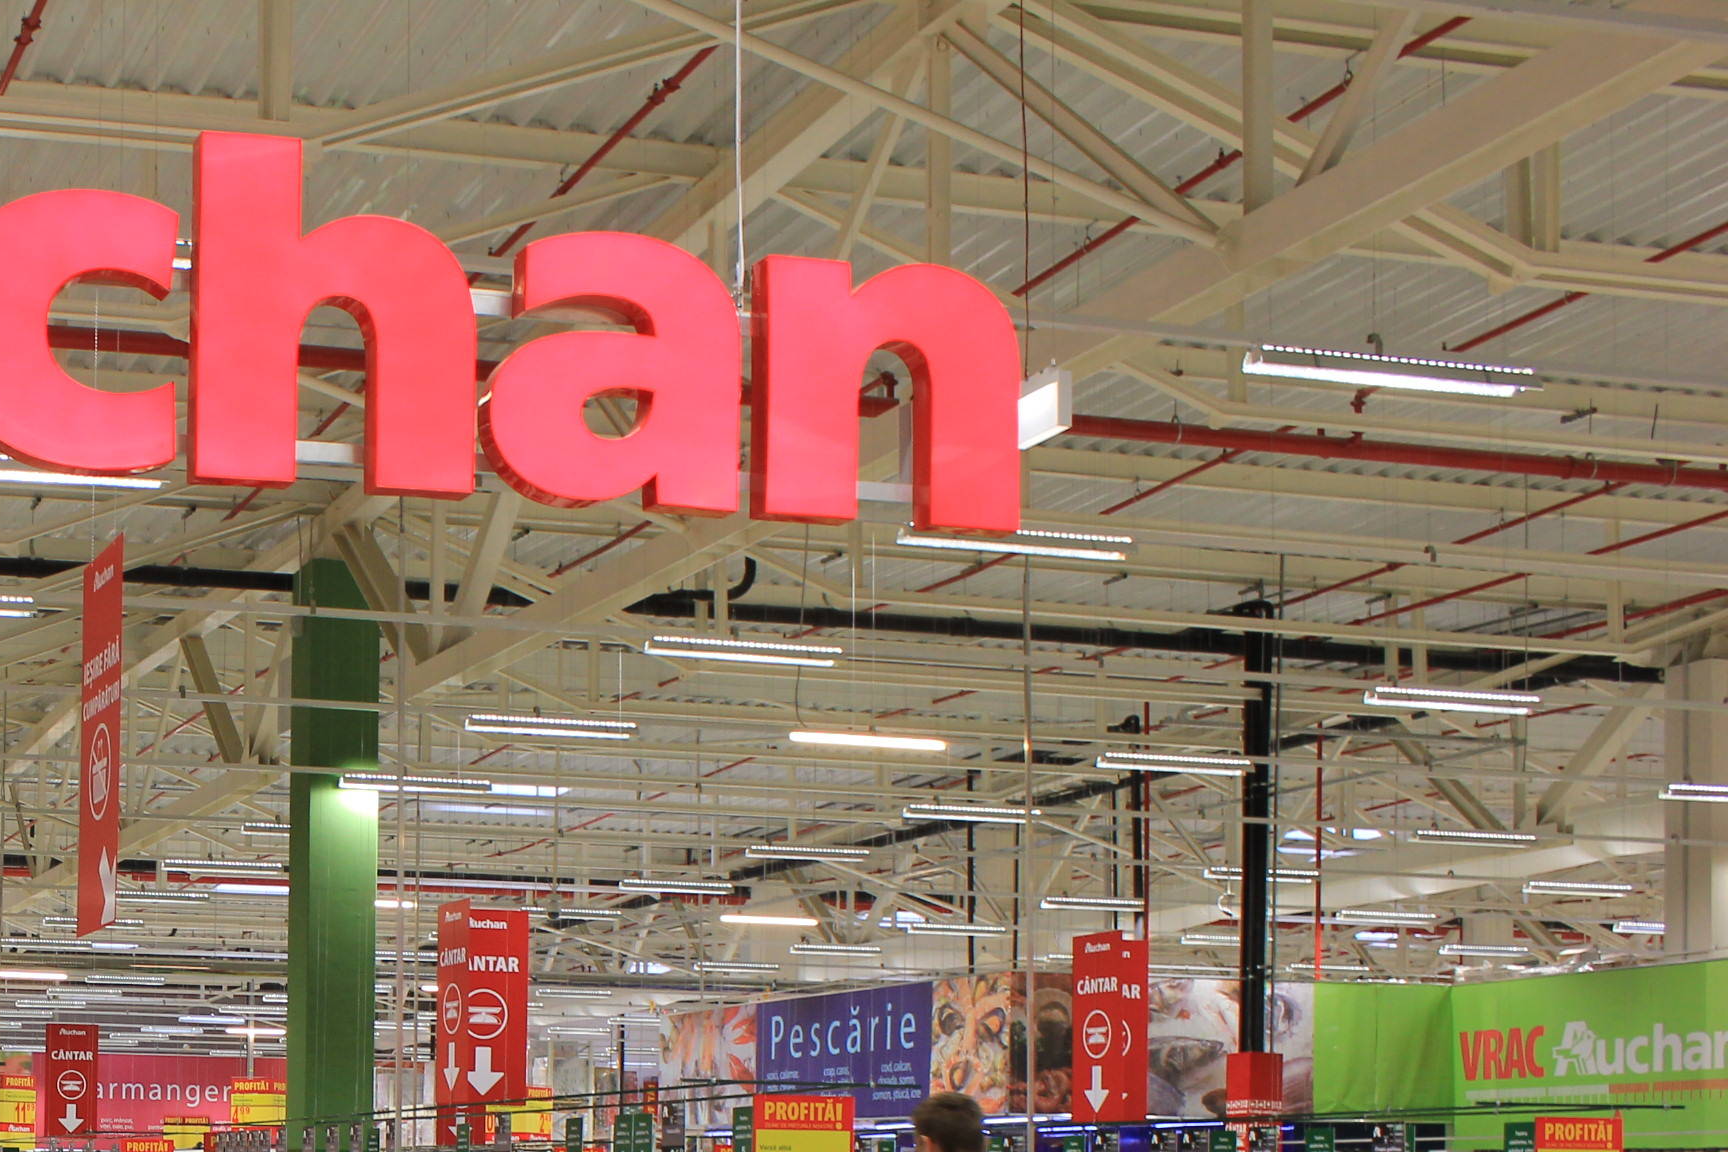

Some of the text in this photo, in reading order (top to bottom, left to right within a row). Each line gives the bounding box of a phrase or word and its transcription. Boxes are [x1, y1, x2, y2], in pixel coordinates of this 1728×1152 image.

[440, 947, 466, 967] CÂNTAR
[469, 955, 519, 972] NTAR
[1077, 975, 1118, 995] CÂNTAR
[59, 1027, 86, 1036] Auchan
[770, 1003, 916, 1059] Pescărie
[51, 1049, 93, 1061] CÂNTAR
[1459, 1025, 1545, 1081] VRAC
[97, 1082, 231, 1107] armanger
[234, 1081, 269, 1091] PROFITĂ!
[764, 1099, 843, 1130] PROFITĂ!
[1545, 1120, 1613, 1149] PROFITĂ!
